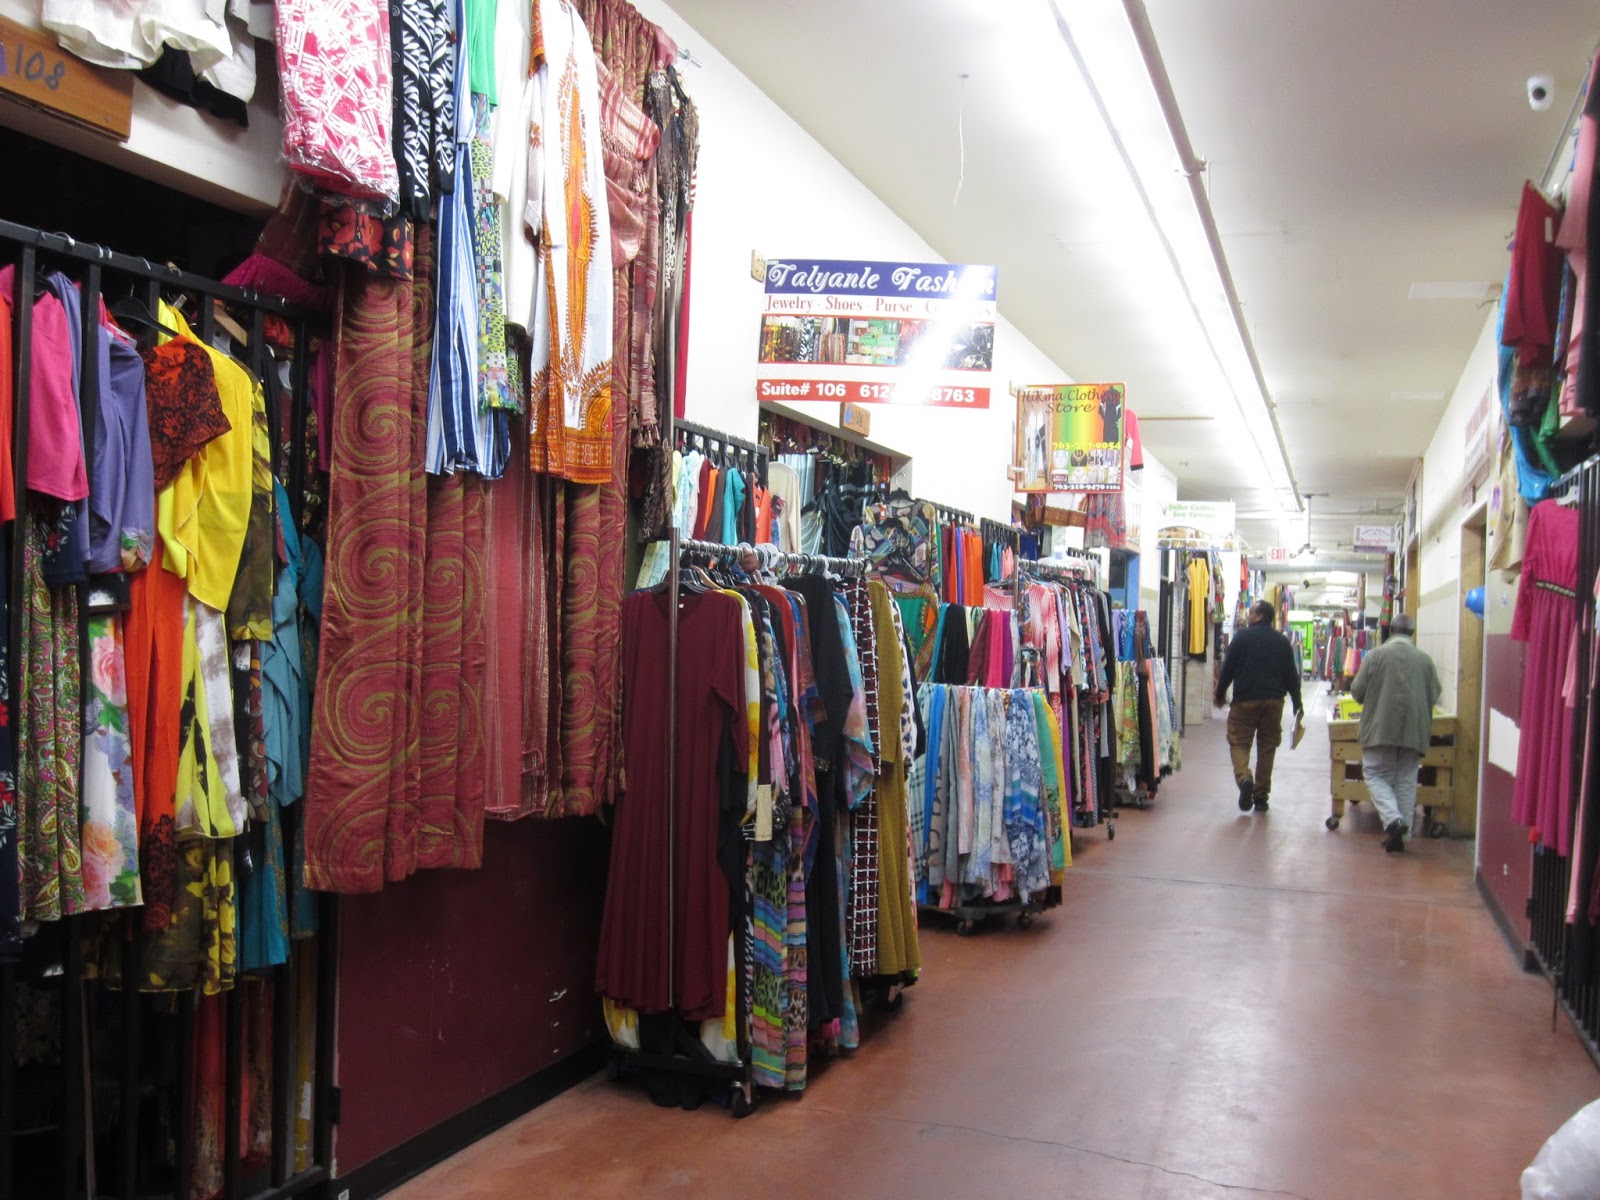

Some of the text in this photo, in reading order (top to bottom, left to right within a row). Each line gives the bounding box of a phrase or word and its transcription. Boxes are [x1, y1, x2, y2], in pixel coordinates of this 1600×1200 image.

[15, 42, 65, 91] 108
[769, 263, 994, 295] Talyanle Fashn
[765, 295, 813, 312] Jewelry
[825, 296, 863, 311] Shoes
[875, 298, 913, 313] Purse
[762, 382, 810, 396] Suite#
[816, 382, 847, 397] 106
[1045, 402, 1095, 414] Store
[1271, 548, 1286, 560] EXIT
